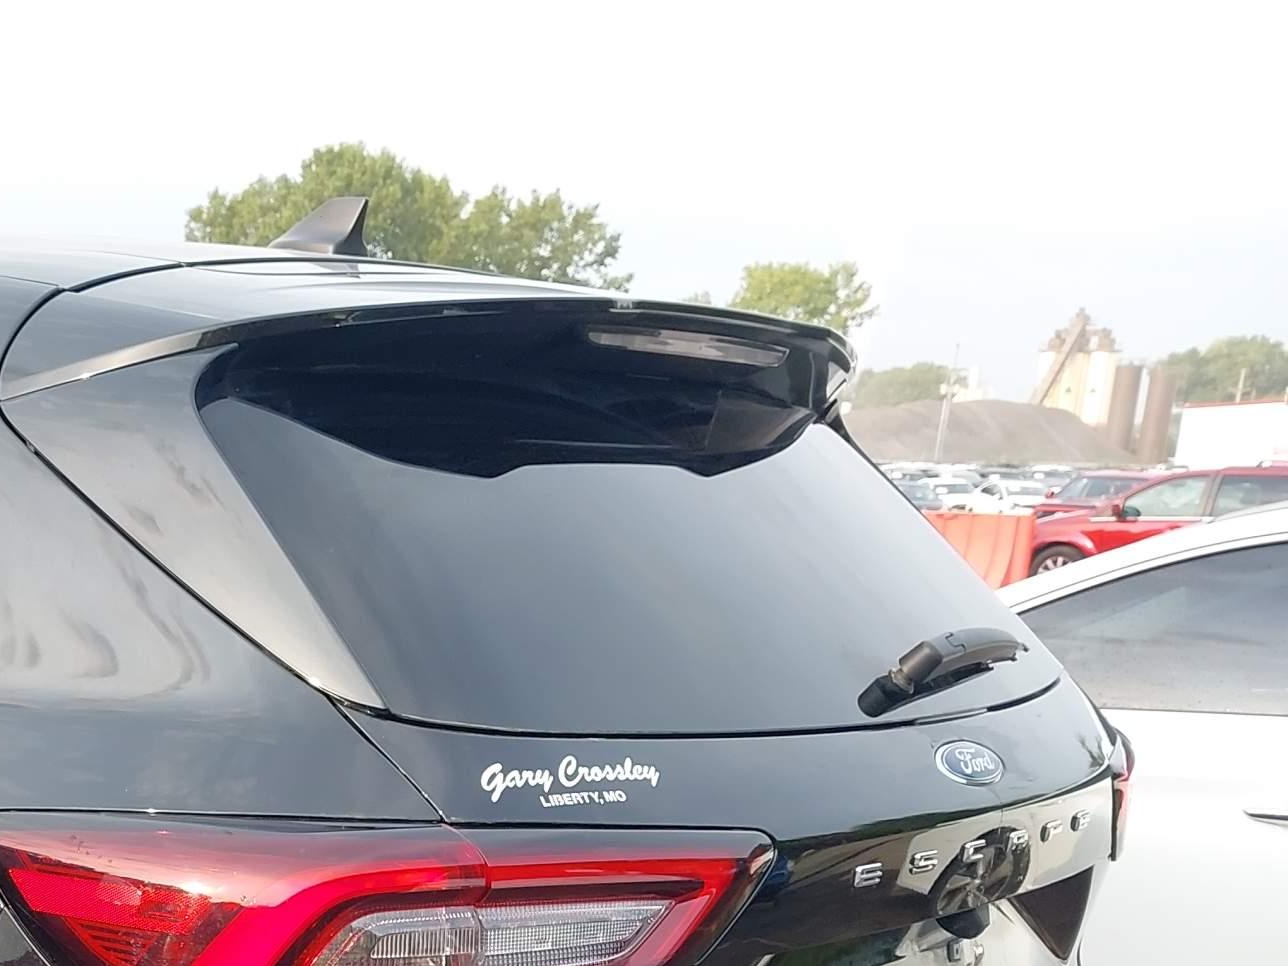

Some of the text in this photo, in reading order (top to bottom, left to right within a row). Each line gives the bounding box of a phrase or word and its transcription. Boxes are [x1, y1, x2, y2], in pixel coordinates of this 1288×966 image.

[480, 755, 660, 803] Gary Crossley
[955, 747, 996, 775] Ford
[852, 808, 1092, 888] ESCAPE
